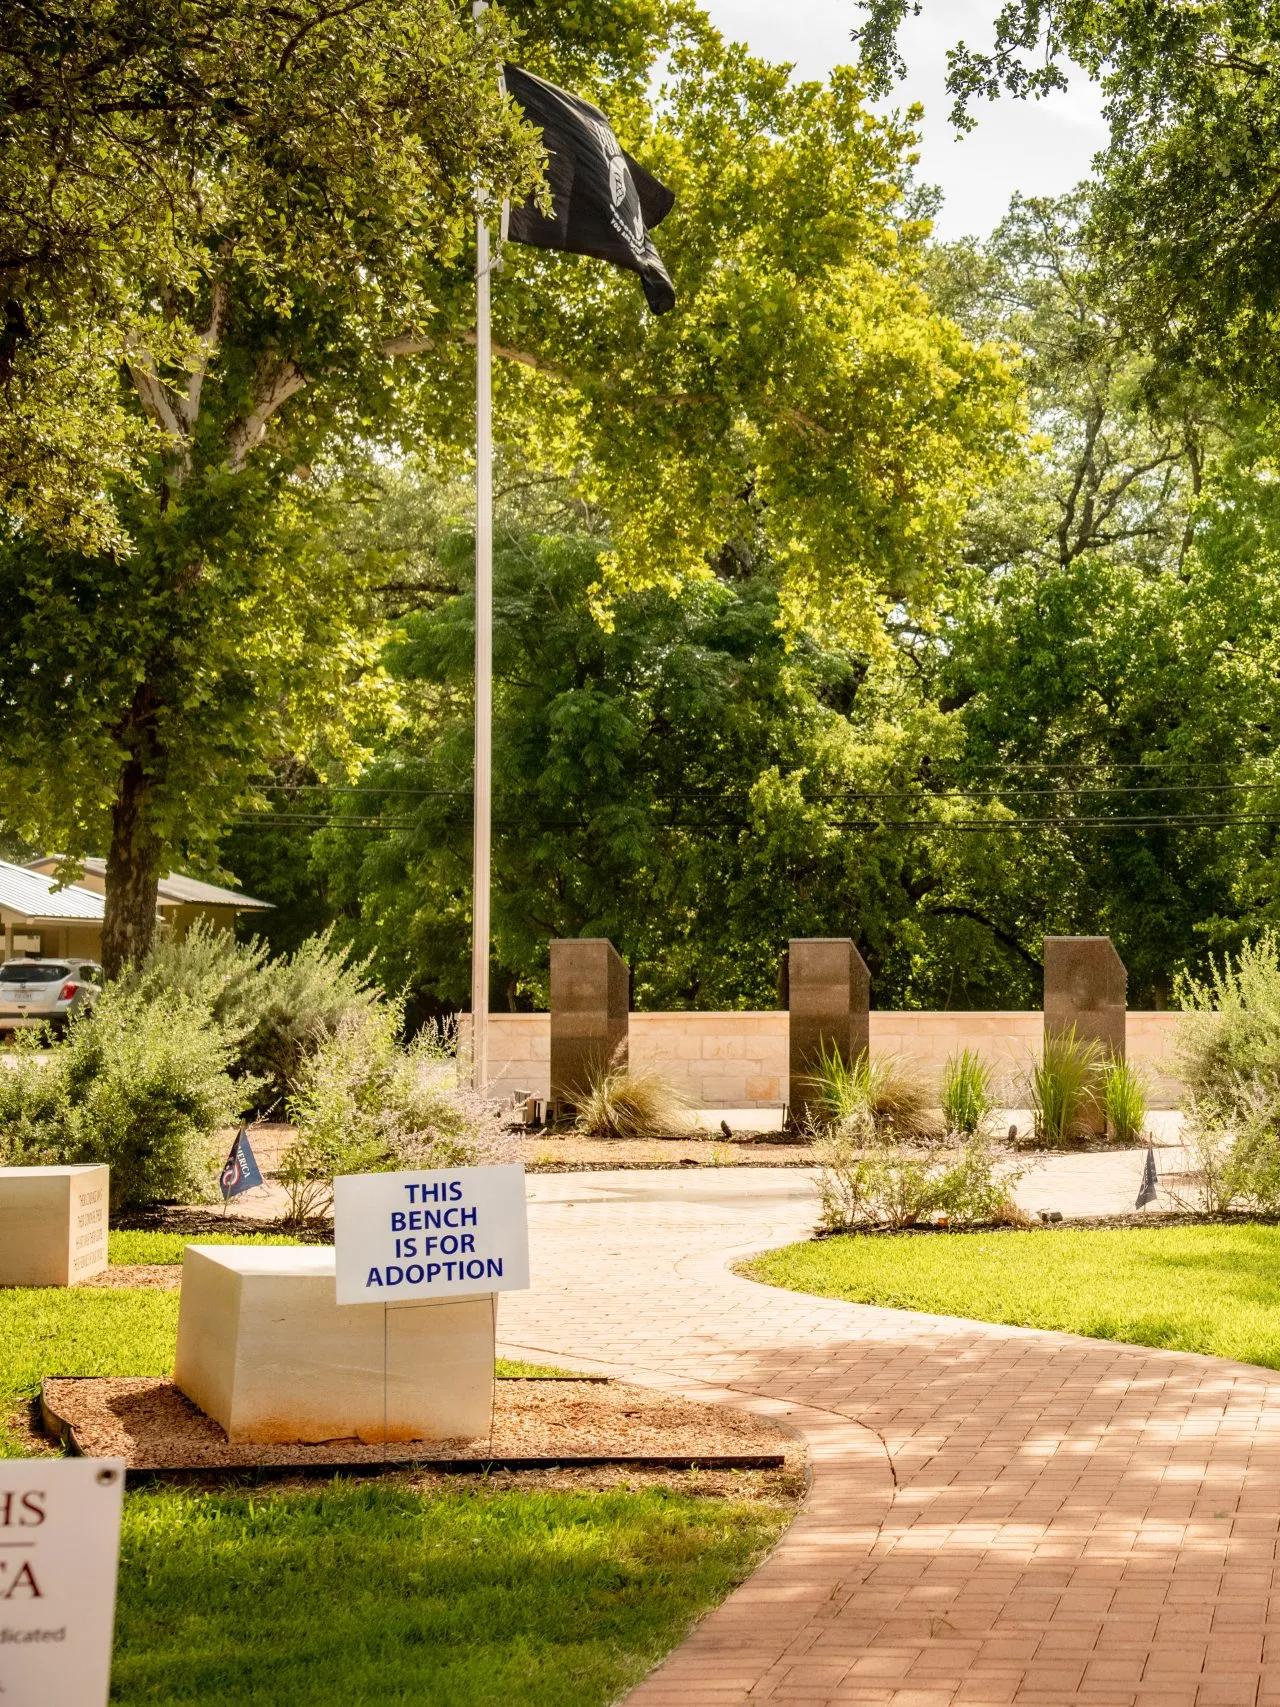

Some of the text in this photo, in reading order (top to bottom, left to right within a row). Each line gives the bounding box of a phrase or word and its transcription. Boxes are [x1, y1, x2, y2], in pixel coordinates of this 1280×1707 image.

[404, 1181, 463, 1204] THIS
[391, 1206, 477, 1232] BENCH
[395, 1233, 476, 1259] IS FOR
[365, 1257, 503, 1288] ADOPTION
